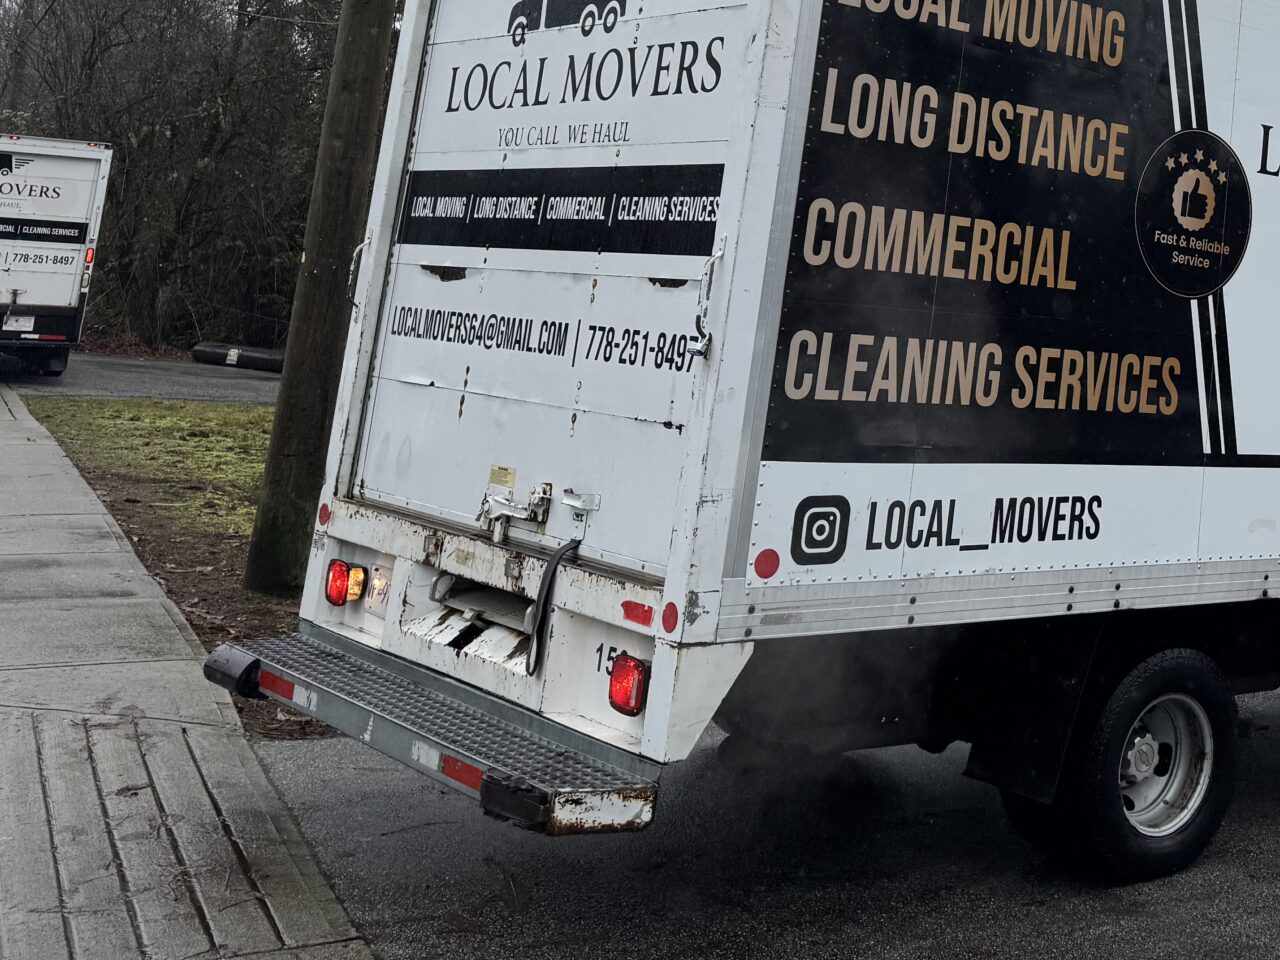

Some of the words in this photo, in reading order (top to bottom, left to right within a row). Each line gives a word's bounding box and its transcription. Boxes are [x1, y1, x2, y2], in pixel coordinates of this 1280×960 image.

[445, 56, 551, 113] LOCAL
[560, 36, 724, 104] MOVERS
[498, 127, 524, 147] YOU
[527, 125, 559, 146] CALL
[568, 124, 589, 144] WE
[592, 121, 631, 143] HAUL
[821, 67, 939, 148] LONG
[948, 91, 1129, 181] DISTANCE
[411, 196, 434, 217] LOCAL
[435, 196, 467, 218] MOVING
[473, 196, 496, 219] LONG
[496, 196, 538, 219] DISTANCE
[546, 196, 606, 220] COMMERCIAL
[617, 196, 668, 221] CLEANING
[669, 195, 720, 222] SERVICES
[22, 226, 51, 235] CLEANING
[51, 228, 79, 237] SERVICES
[803, 198, 1077, 291] COMMERCIAL
[1154, 230, 1178, 246] Fast
[1179, 235, 1187, 247] &
[1189, 237, 1230, 255] Reliable
[12, 253, 75, 266] 778-251-8497
[1172, 251, 1210, 269] Service
[391, 306, 569, 357] LOCALMOVERS64@GMAIL.COM
[585, 325, 700, 373] 778-251-8497
[784, 330, 1003, 407] CLEANING
[1011, 345, 1181, 416] SERVICES
